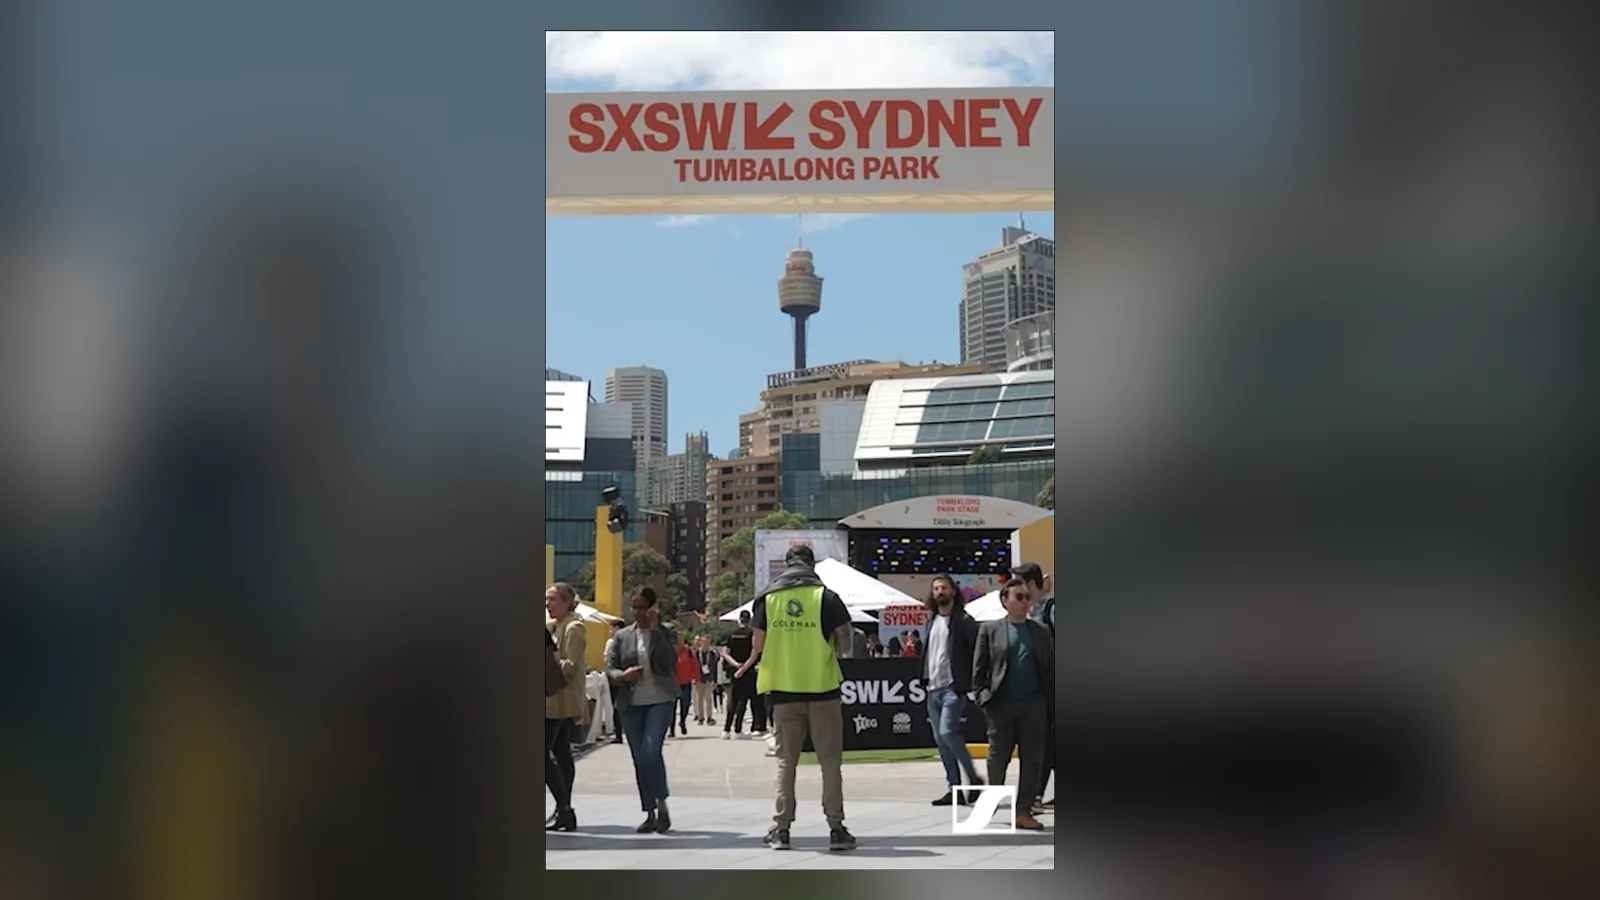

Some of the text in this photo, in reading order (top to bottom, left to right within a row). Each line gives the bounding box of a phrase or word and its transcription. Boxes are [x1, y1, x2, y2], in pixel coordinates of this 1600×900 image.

[568, 98, 1043, 153] SXSW SYDNEY
[674, 155, 940, 183] TUMBALONG PARK
[772, 620, 817, 629] COLEMAN
[840, 680, 880, 704] SW
